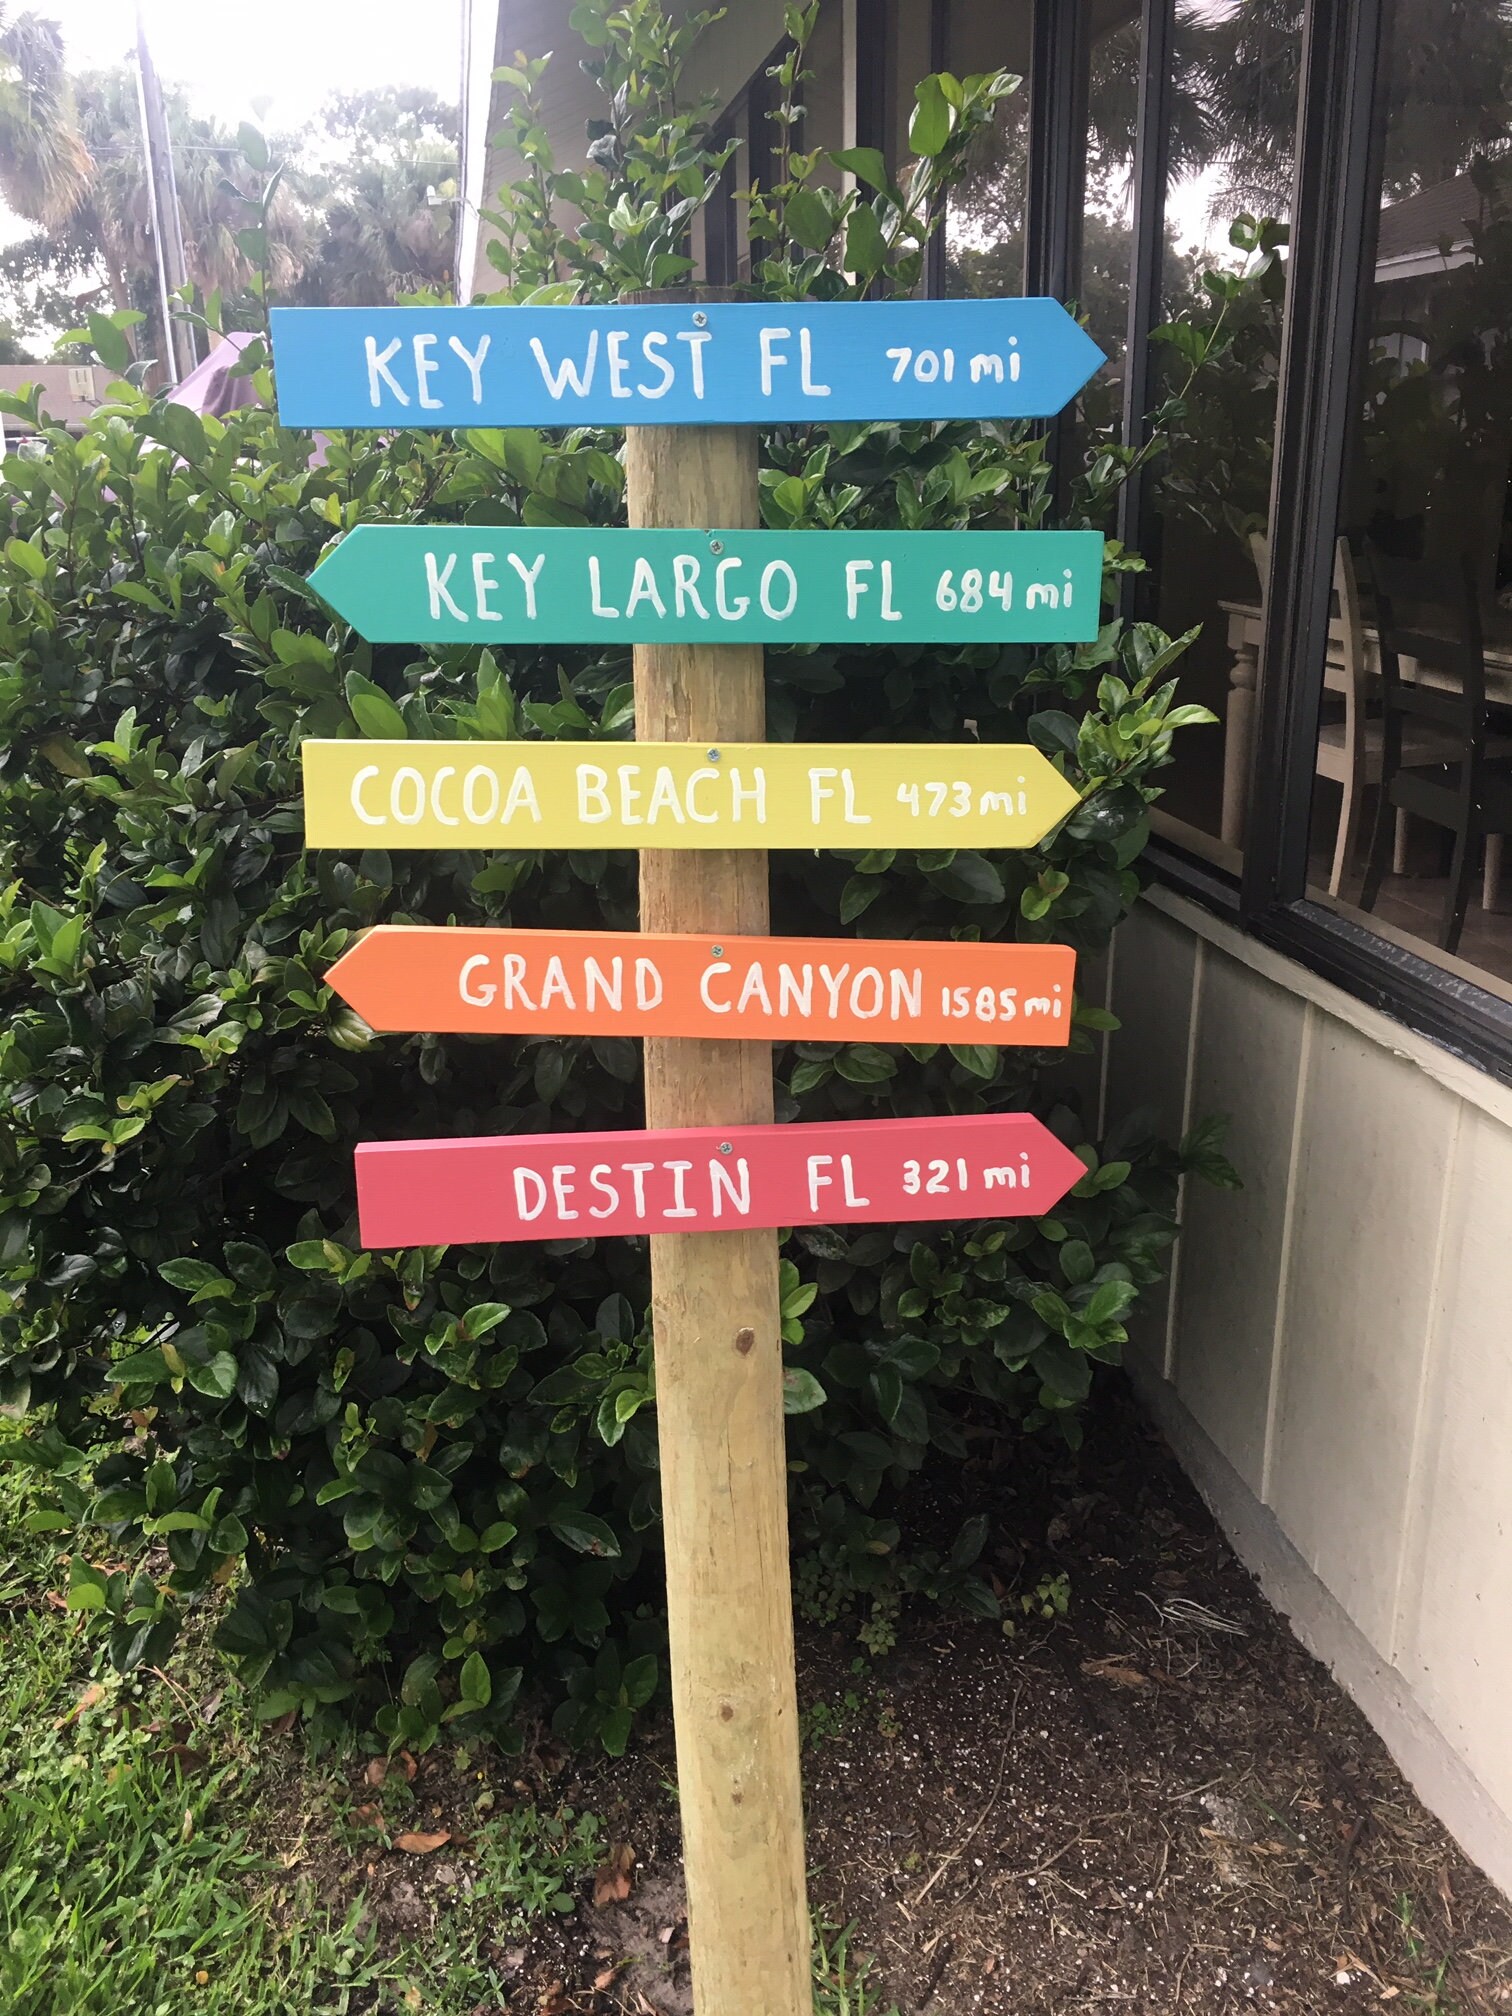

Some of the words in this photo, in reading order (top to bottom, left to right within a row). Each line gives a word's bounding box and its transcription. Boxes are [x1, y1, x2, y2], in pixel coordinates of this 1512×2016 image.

[364, 333, 491, 409] KEY
[529, 329, 712, 400] WEST
[759, 327, 831, 396] FL
[886, 347, 956, 383] 701
[969, 336, 1021, 383] mi
[424, 551, 546, 623] KEY
[588, 555, 798, 621] LARGO
[845, 559, 903, 621] FL
[935, 568, 1013, 613] 684
[1025, 569, 1073, 611] mi
[350, 764, 542, 827] COCOA
[575, 763, 767, 826] BEACH
[807, 767, 872, 825] FL
[896, 780, 972, 818] 473
[979, 775, 1027, 817] mi
[459, 953, 663, 1012] GRAND
[700, 961, 923, 1024] CANYON
[941, 986, 1017, 1022] 1585
[1024, 984, 1062, 1018] mi
[512, 1157, 751, 1221] DESTIN
[807, 1153, 870, 1213] FL
[902, 1157, 968, 1195] 321
[983, 1152, 1030, 1190] mi
